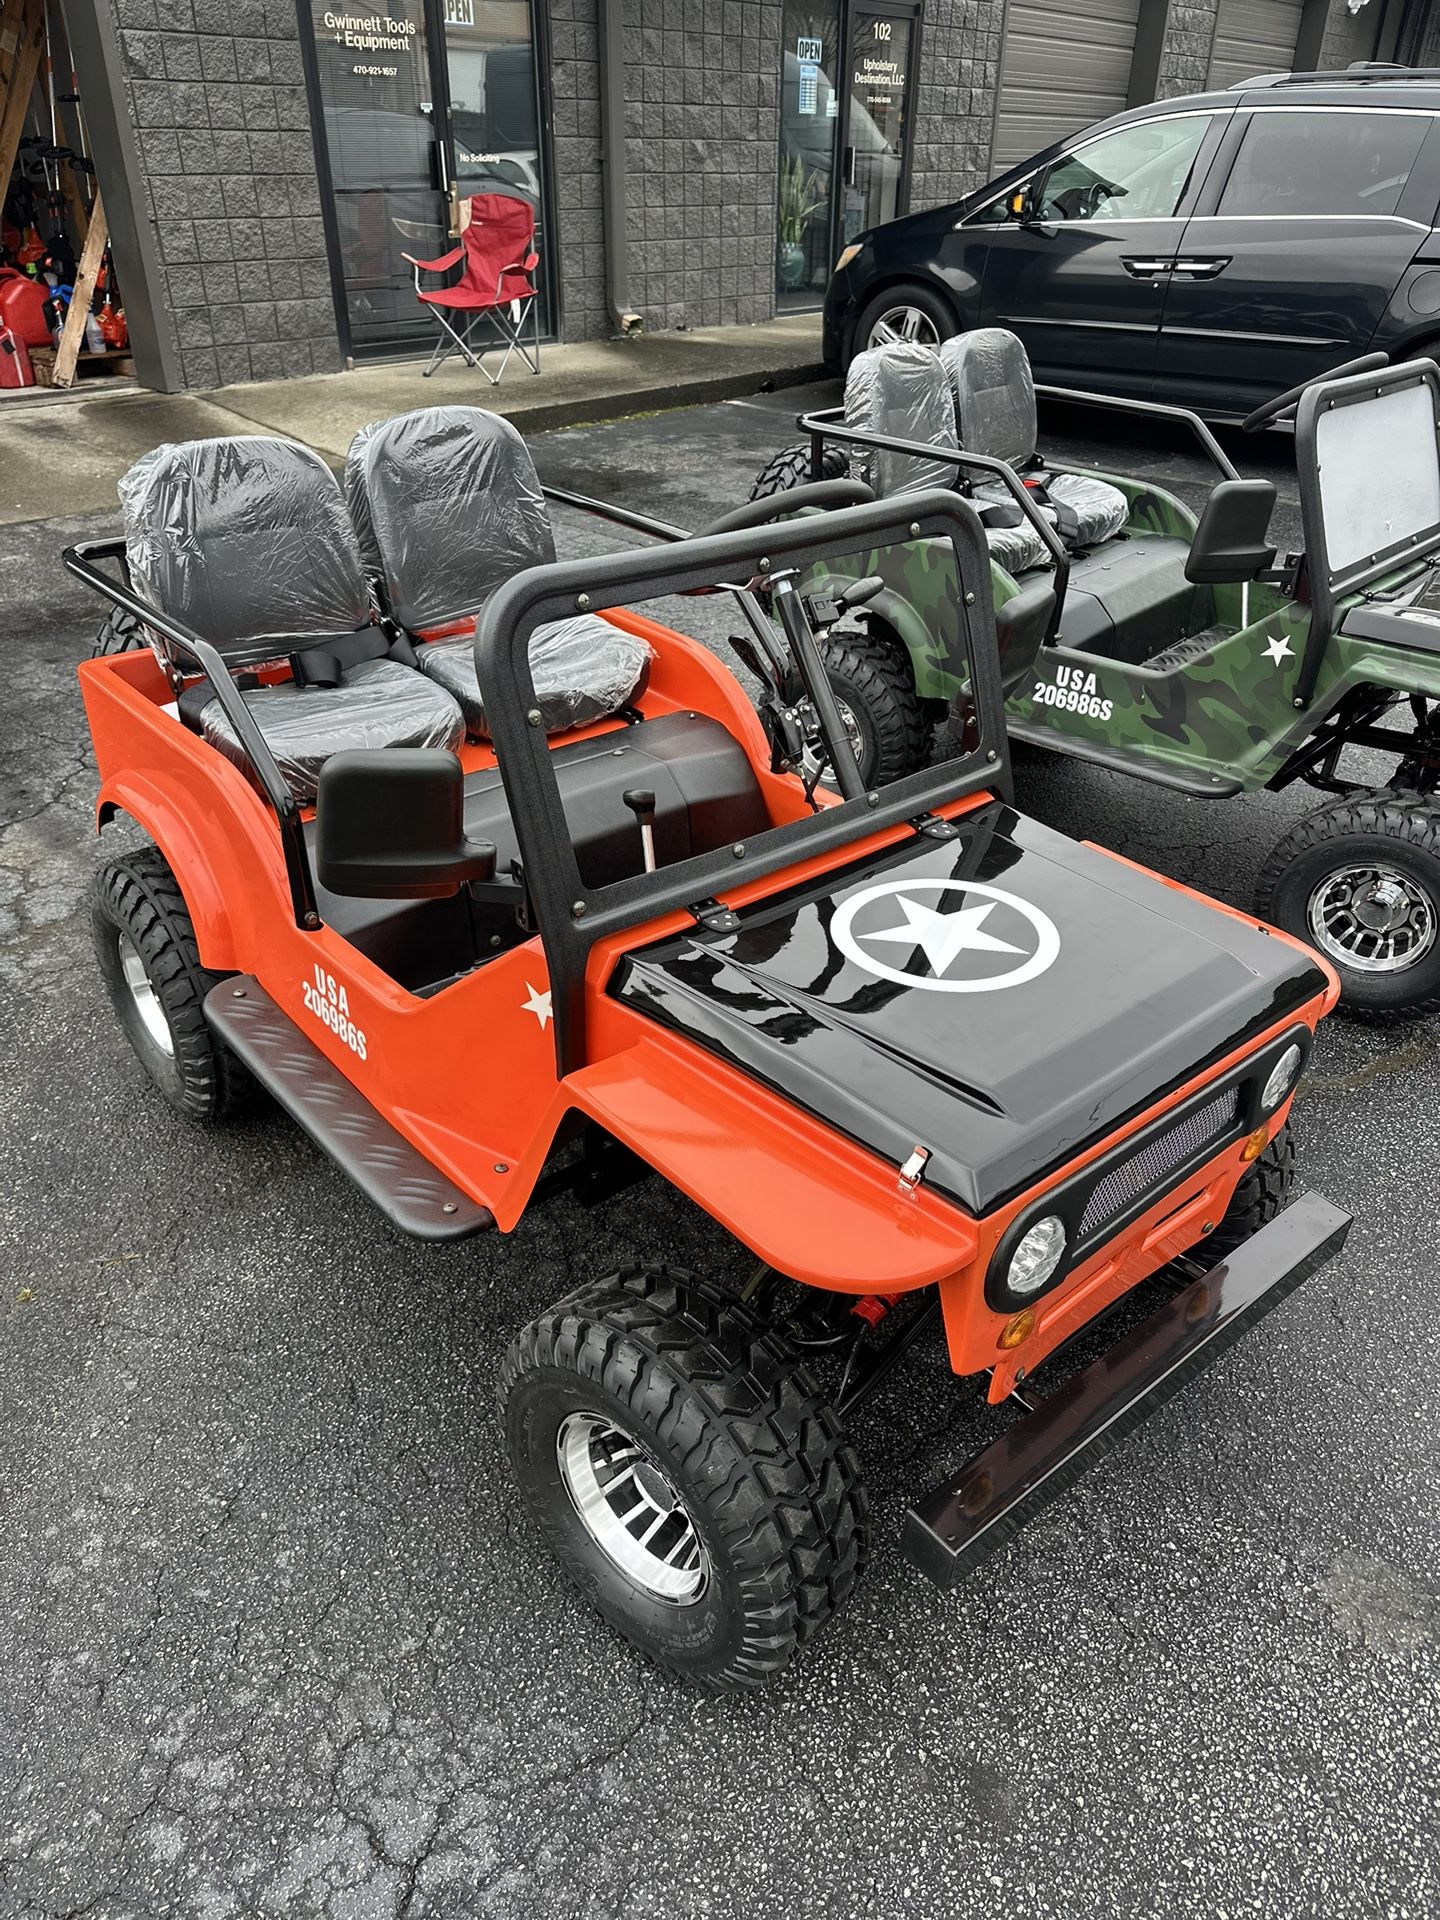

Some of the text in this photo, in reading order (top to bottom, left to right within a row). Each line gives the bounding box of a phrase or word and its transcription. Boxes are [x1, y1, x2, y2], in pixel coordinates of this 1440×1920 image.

[443, 0, 472, 23] PEN
[324, 11, 416, 35] Gwinnett Tools
[873, 22, 891, 41] 102
[334, 30, 410, 51] + Equipment
[799, 40, 821, 60] OPEN
[352, 65, 398, 76] 470-921-1657
[863, 58, 897, 73] Upholstery
[892, 74, 906, 87] LLC
[459, 153, 501, 164] No Soliciting
[1055, 665, 1097, 695] USA
[1032, 681, 1114, 722] 206986S
[313, 962, 350, 1018] USA
[302, 980, 367, 1061] 206986S
